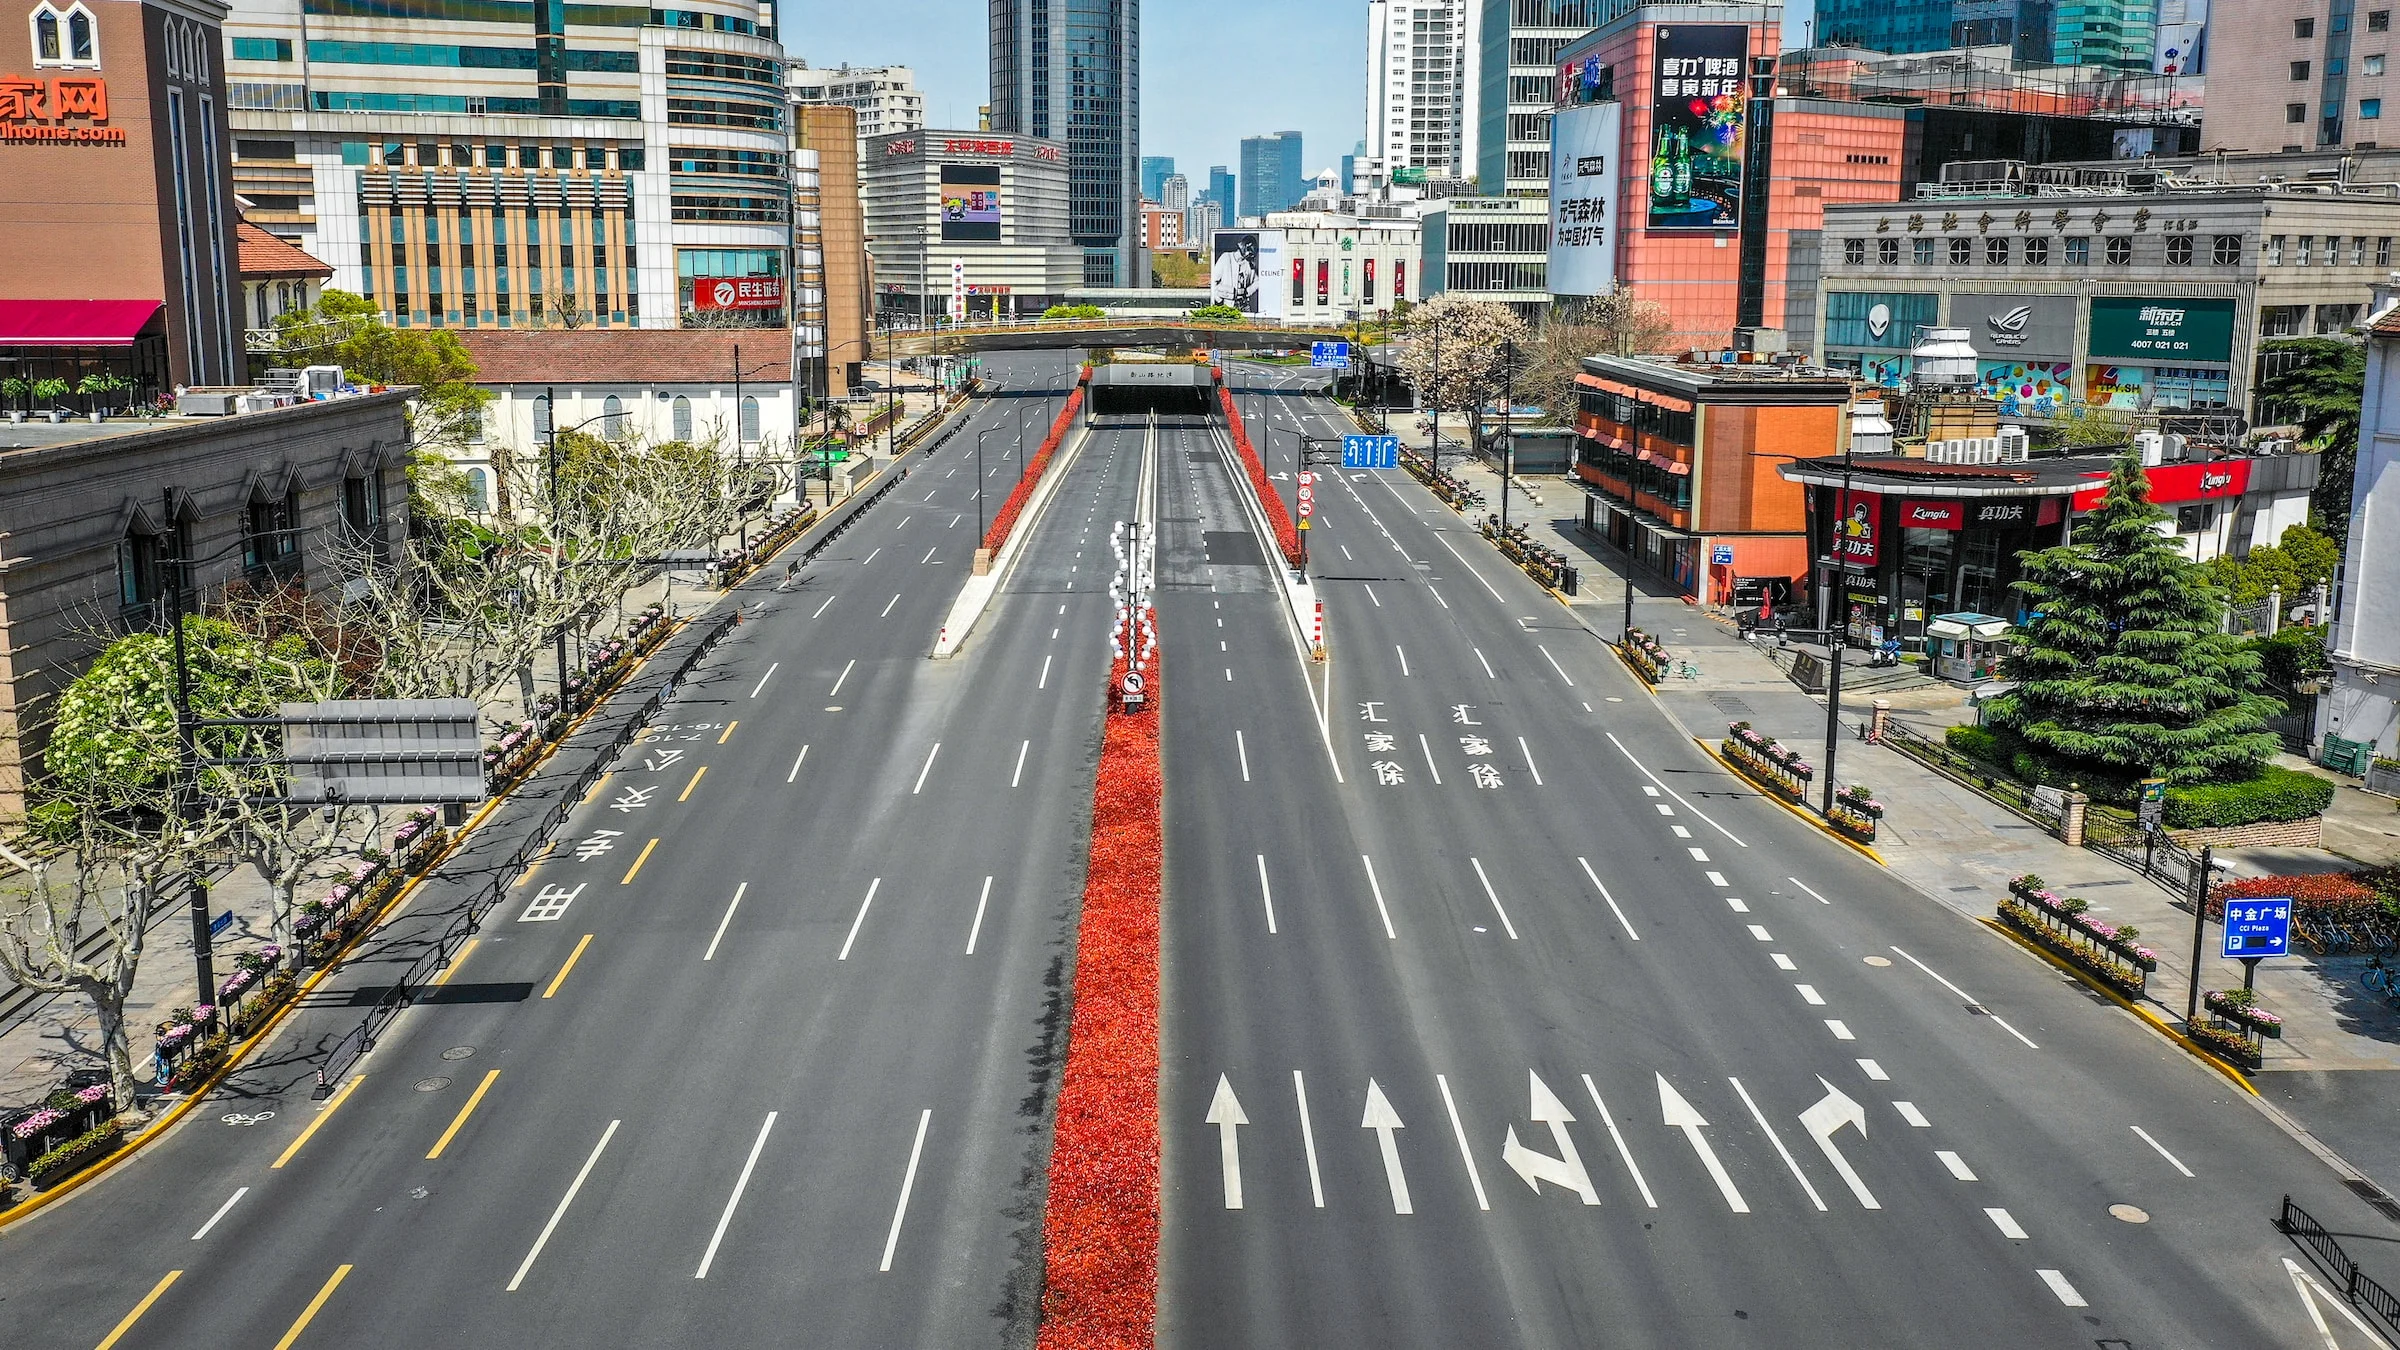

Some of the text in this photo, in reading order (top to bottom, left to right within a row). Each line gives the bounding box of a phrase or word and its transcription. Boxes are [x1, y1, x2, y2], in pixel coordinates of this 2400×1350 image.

[1661, 79, 1739, 97] 喜寅新年
[1578, 159, 1603, 174] 元气森林
[1559, 197, 1605, 224] 元气森林
[1557, 225, 1605, 247] 为中国打气
[2139, 306, 2185, 326] 新东方
[2131, 340, 2189, 350] 4007 021 021
[1300, 489, 1309, 498] 40
[1912, 506, 1950, 521] Kungfu
[1978, 504, 2024, 521] 真功夫
[1845, 574, 1877, 589] 真功夫
[2230, 907, 2287, 921] 中金广场
